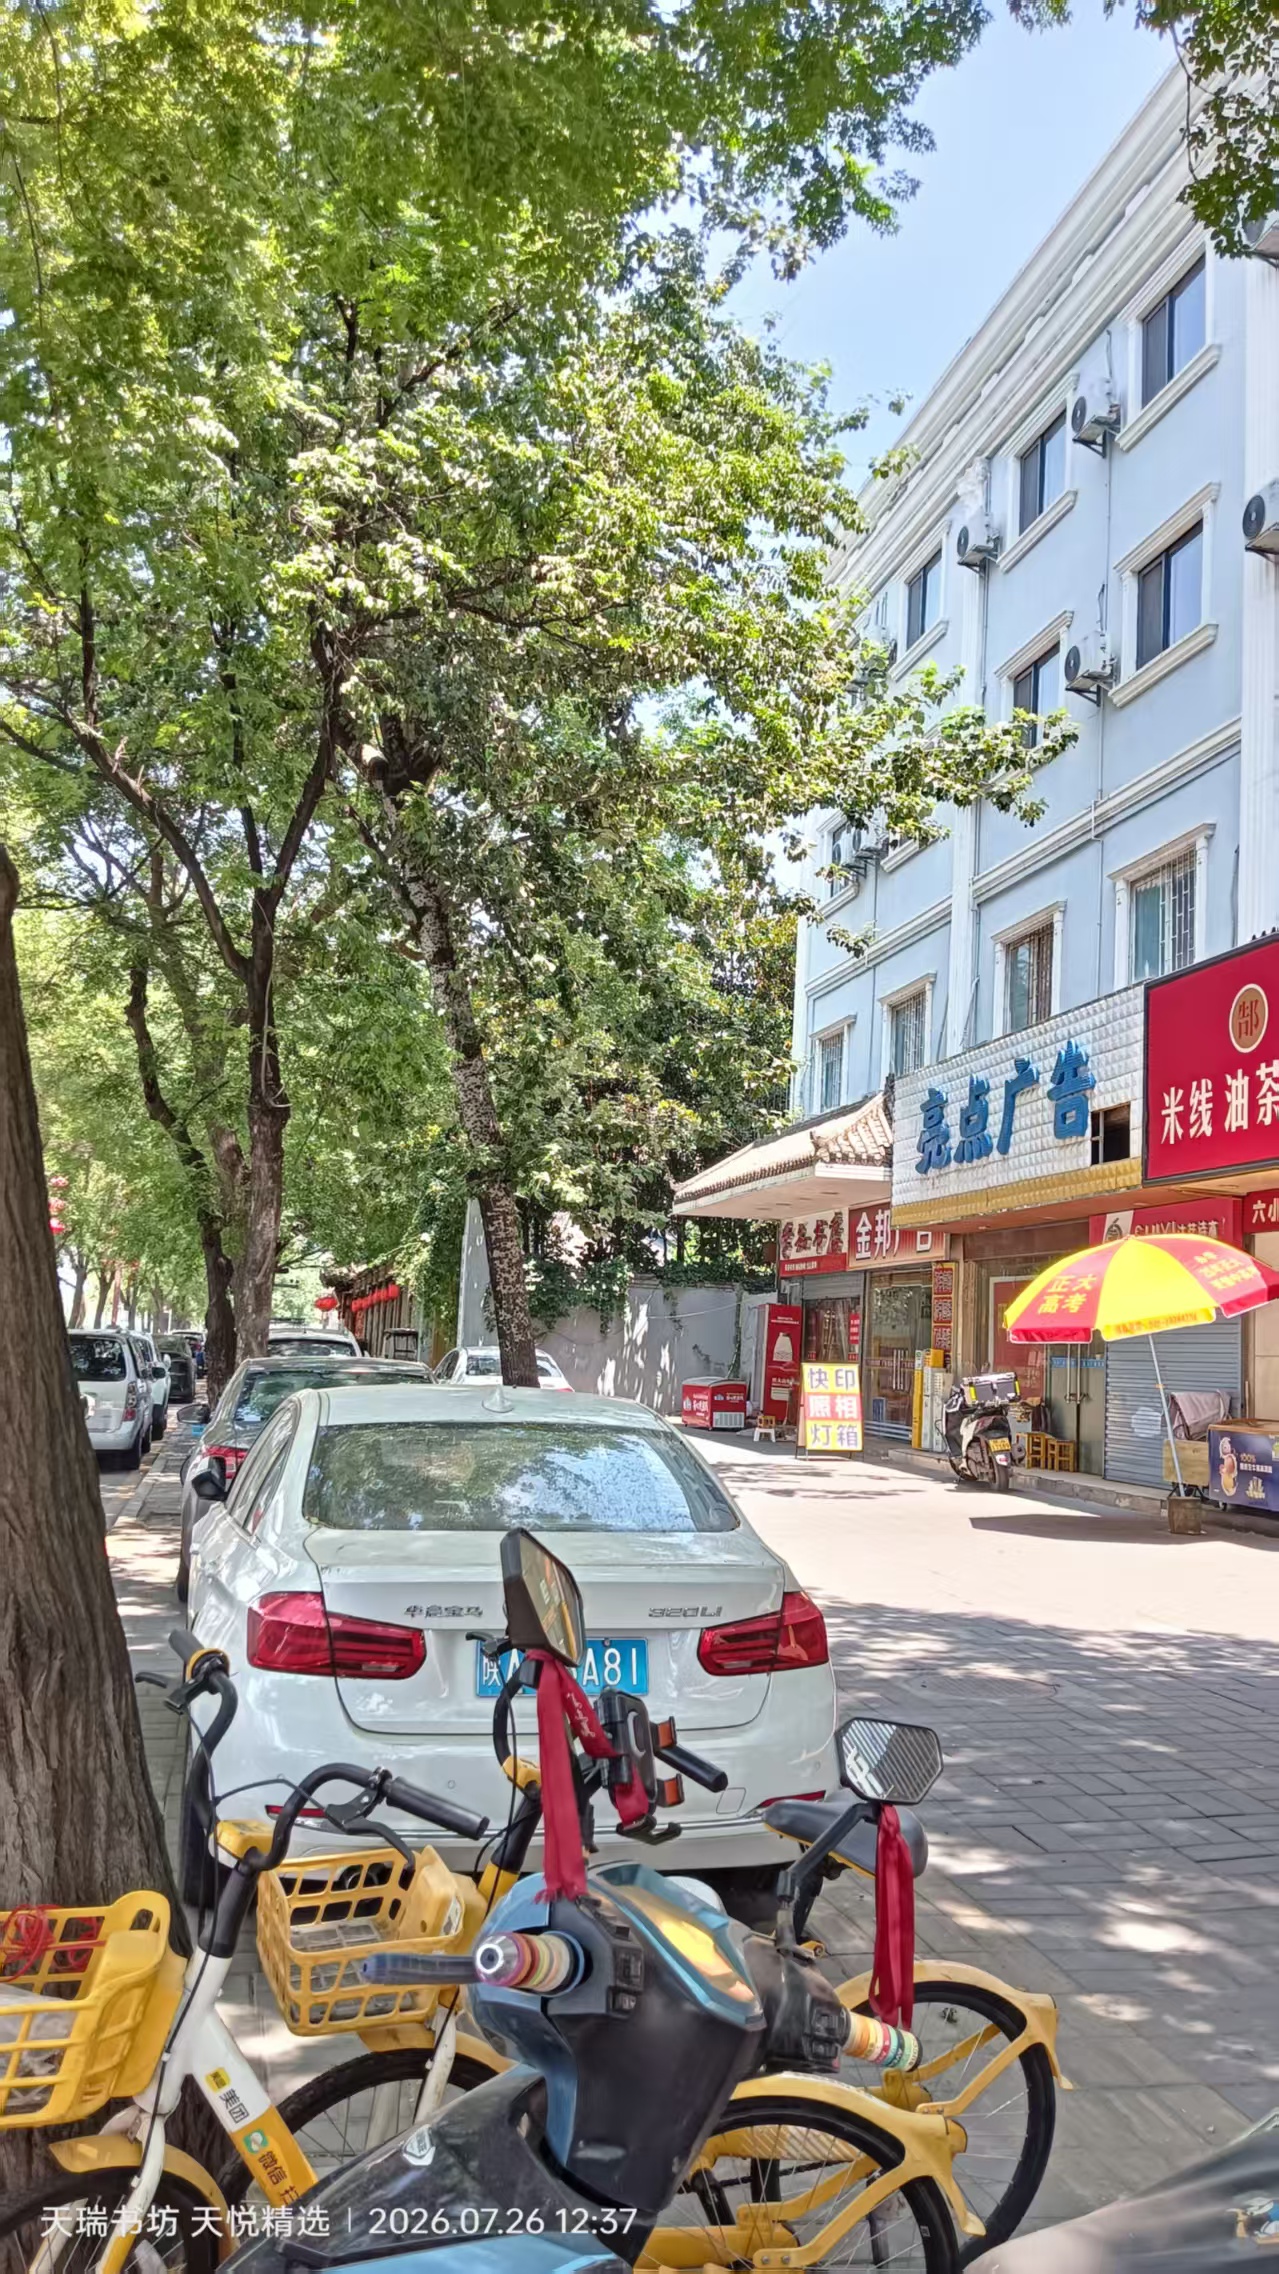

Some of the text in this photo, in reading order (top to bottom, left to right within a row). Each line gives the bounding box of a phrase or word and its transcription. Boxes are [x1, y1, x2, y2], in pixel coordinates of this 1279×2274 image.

[915, 1038, 1096, 1175] 亮点广告
[1161, 1059, 1279, 1144] 米线 油茶
[1047, 1274, 1097, 1293] 正大
[1037, 1293, 1087, 1315] 高考
[808, 1368, 855, 1390] 快印
[809, 1395, 857, 1419] 照相
[811, 1423, 858, 1447] 灯箱
[219, 2089, 249, 2124] 美团
[257, 2151, 287, 2185] 微信
